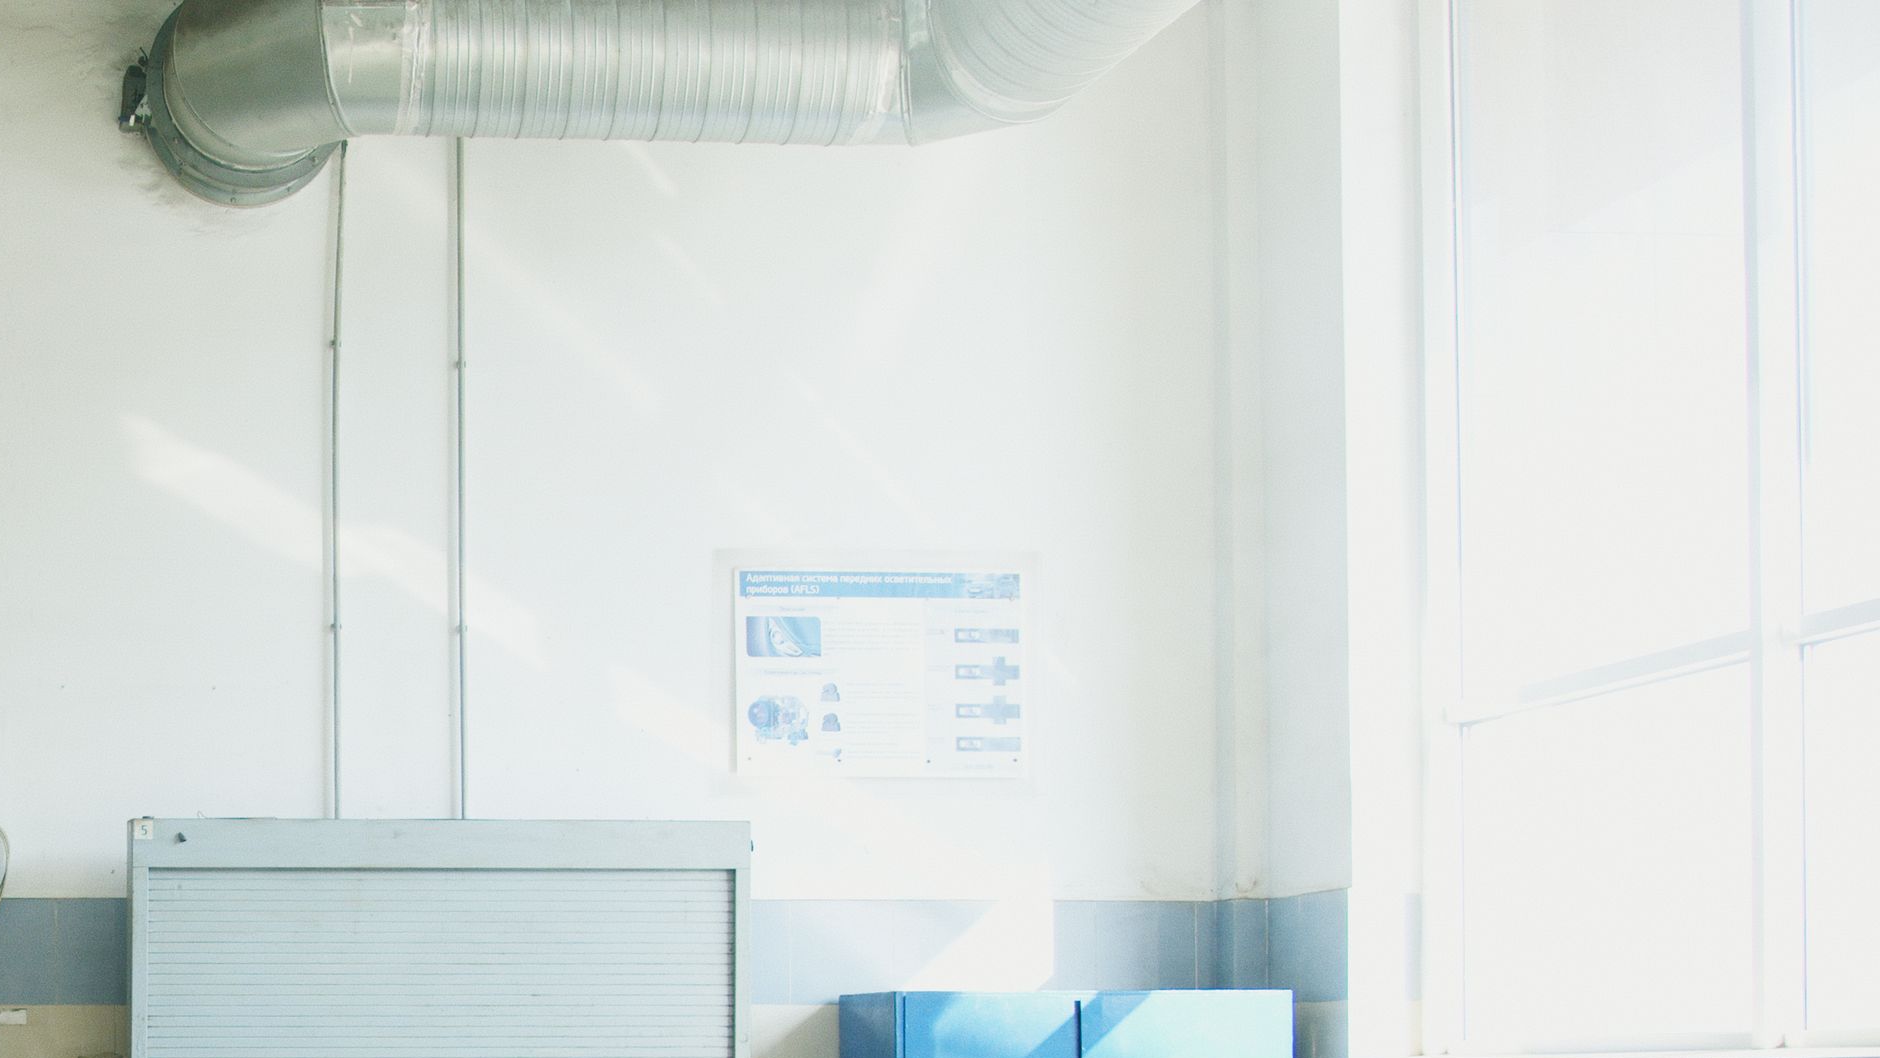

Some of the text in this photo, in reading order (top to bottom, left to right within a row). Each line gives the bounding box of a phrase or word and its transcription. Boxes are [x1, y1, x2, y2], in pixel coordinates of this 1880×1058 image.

[746, 573, 800, 584] Адаптивная
[802, 575, 838, 583] система
[884, 574, 953, 584] осветительных
[746, 584, 820, 595] приборов (AFLS)
[141, 825, 148, 836] 5
